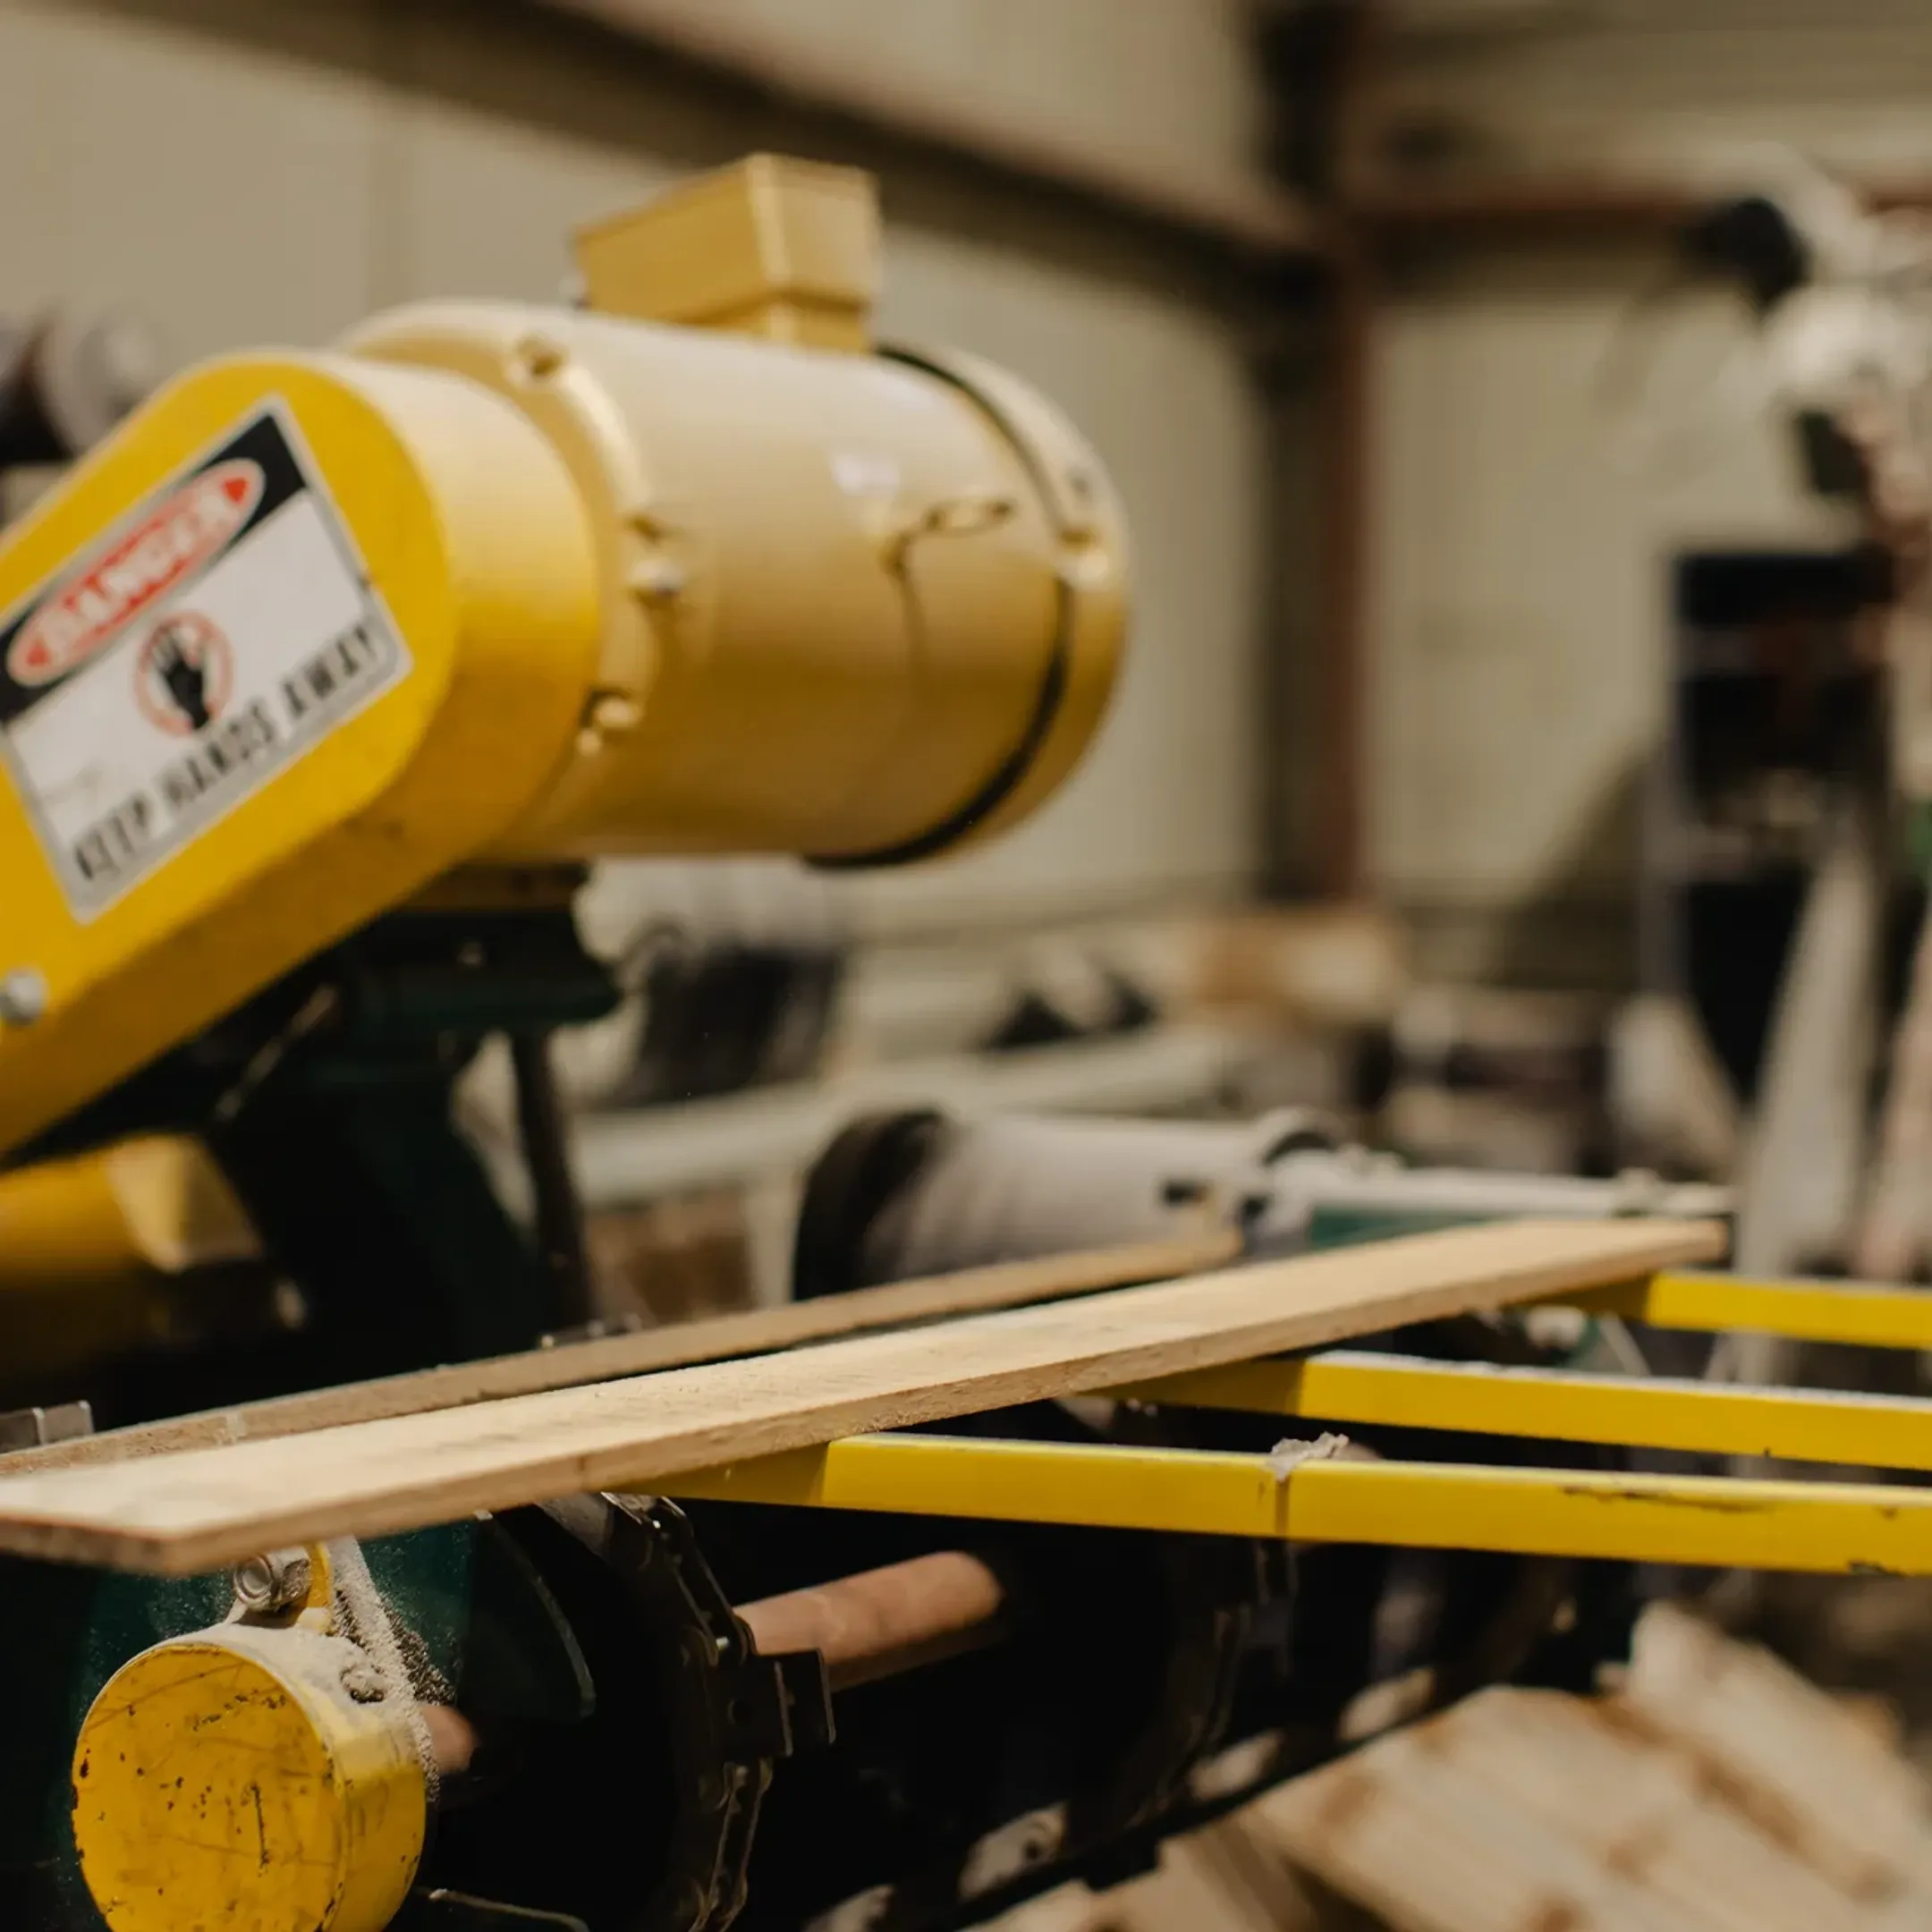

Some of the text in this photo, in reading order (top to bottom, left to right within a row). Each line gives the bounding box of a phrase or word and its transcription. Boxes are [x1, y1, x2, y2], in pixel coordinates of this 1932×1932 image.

[39, 482, 234, 651] DANGER
[72, 624, 380, 881] KEEP HANDS AWAY
